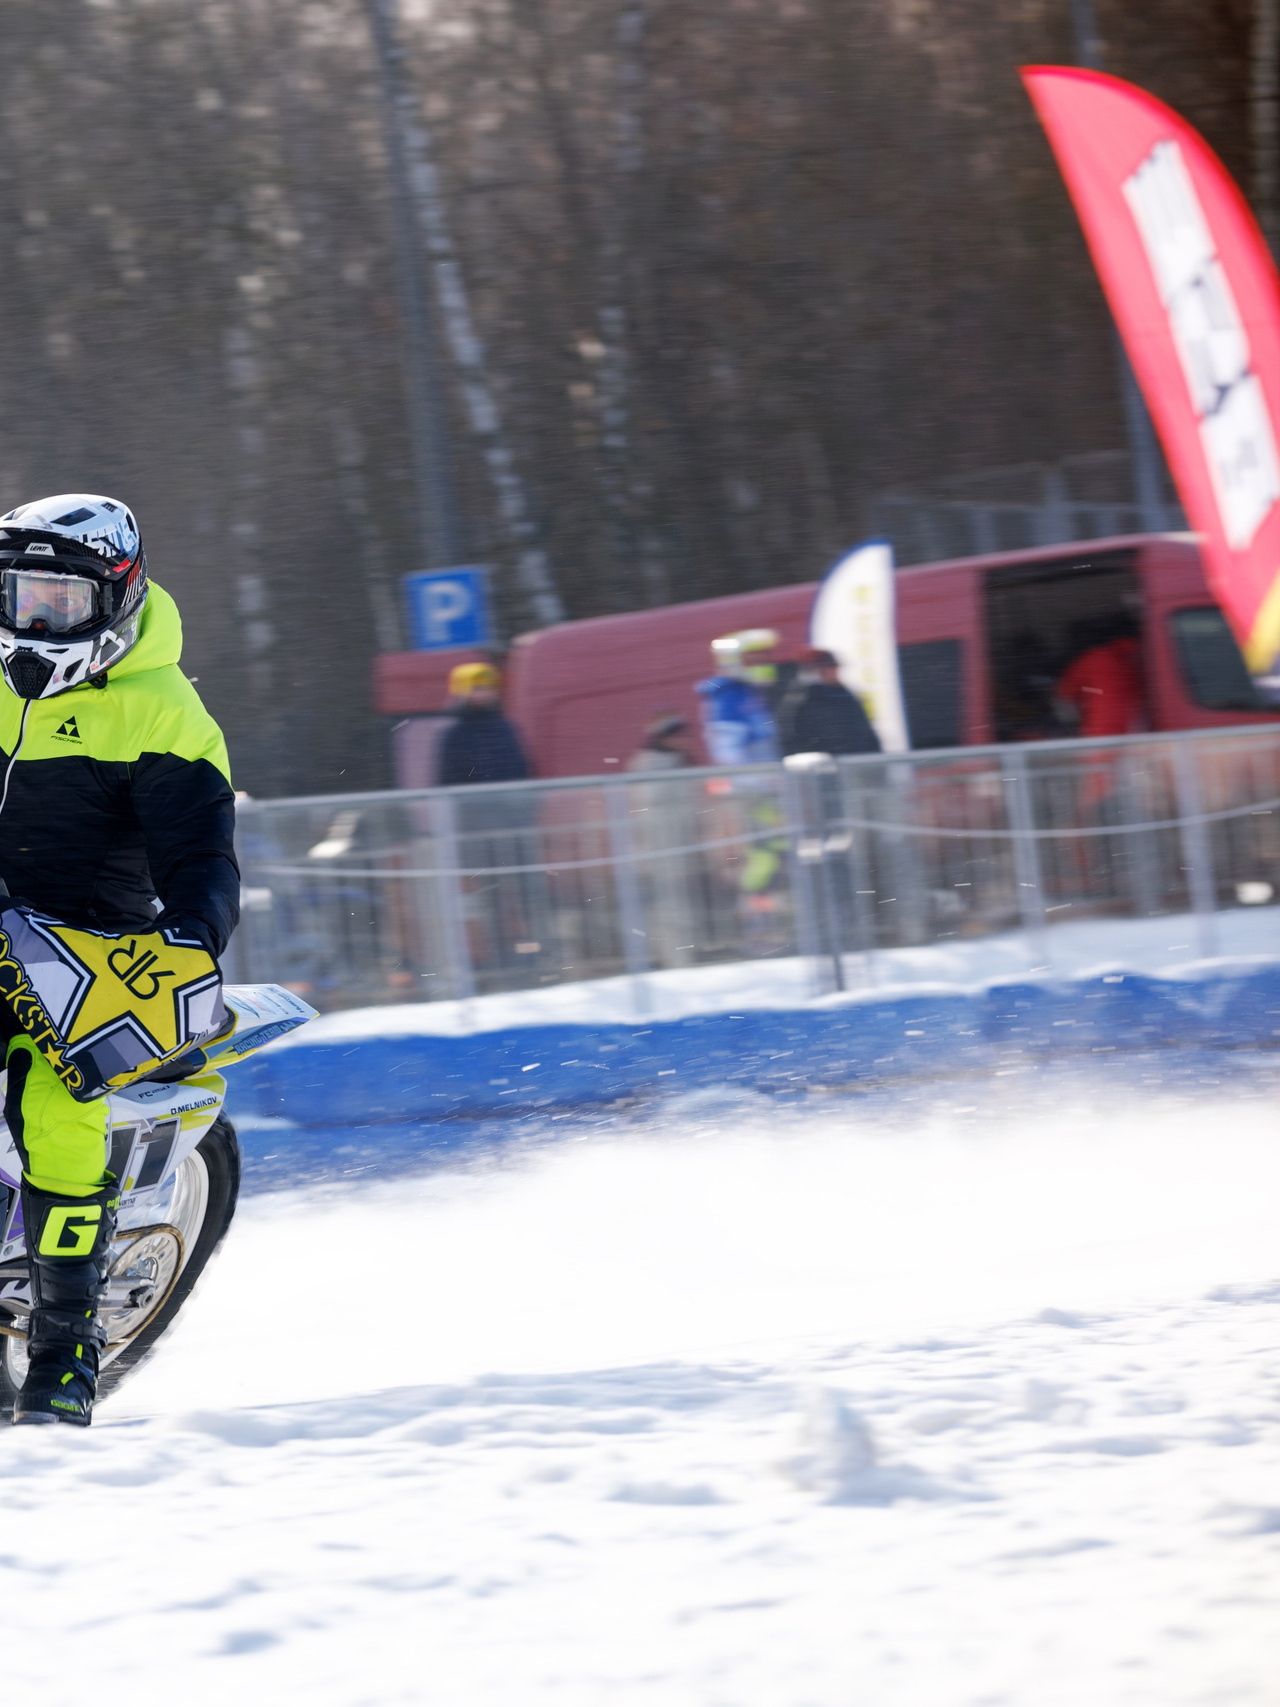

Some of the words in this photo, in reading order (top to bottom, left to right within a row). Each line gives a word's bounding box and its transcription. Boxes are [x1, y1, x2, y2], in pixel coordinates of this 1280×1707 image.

[424, 582, 470, 641] P
[50, 735, 83, 745] FISCHER
[234, 1034, 264, 1054] RACING
[261, 1024, 282, 1042] TEAM
[138, 1090, 153, 1099] FC
[152, 1084, 171, 1095] 250
[170, 1096, 217, 1115] D.MELNIKOV
[38, 1204, 102, 1257] G
